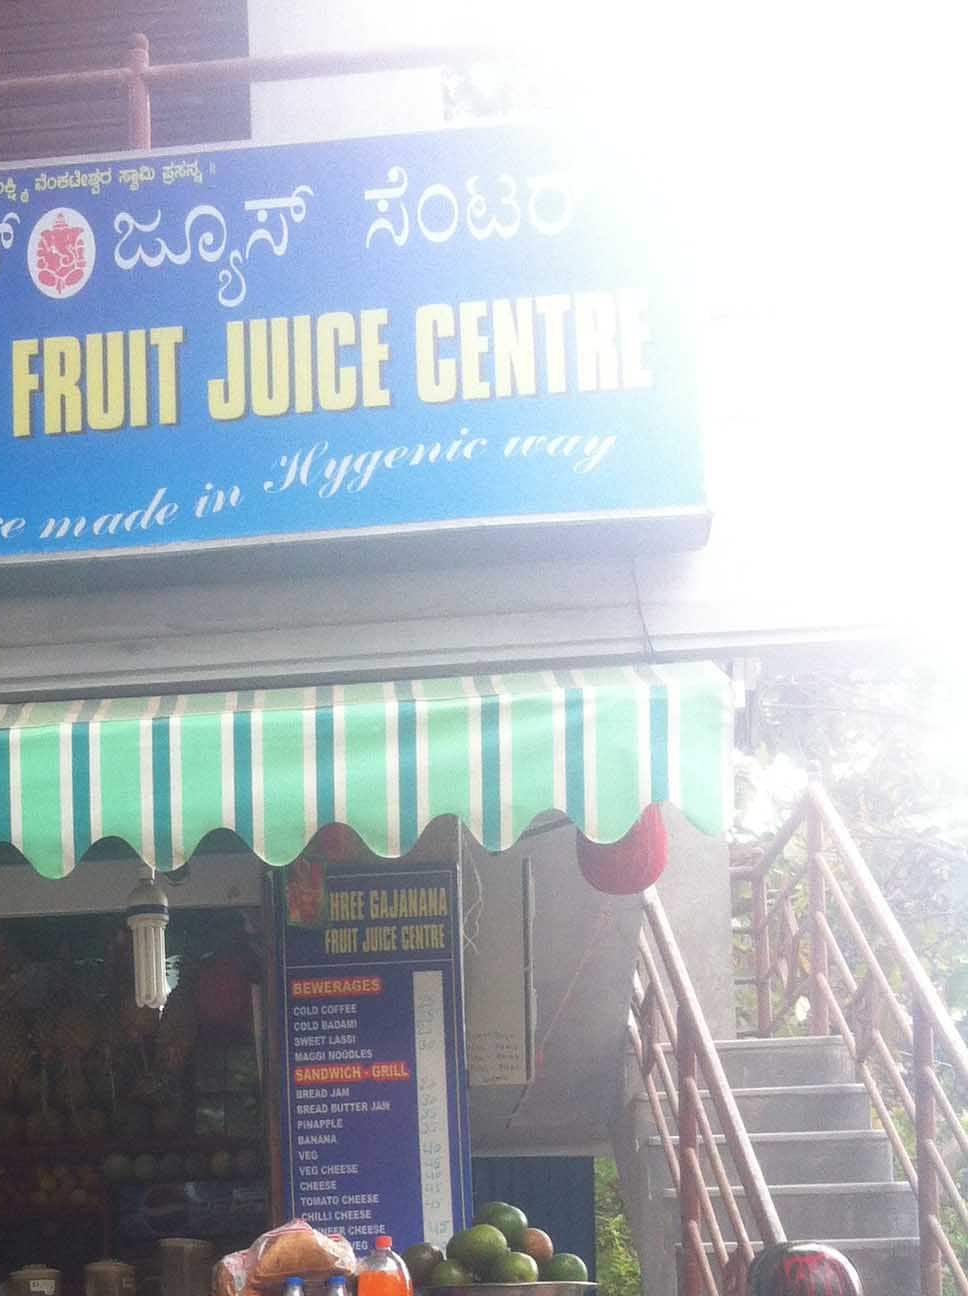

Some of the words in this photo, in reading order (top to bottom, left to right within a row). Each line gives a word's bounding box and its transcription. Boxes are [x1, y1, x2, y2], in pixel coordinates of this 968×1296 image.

[113, 185, 315, 308] ಜ್ಯೂಸ್
[11, 326, 185, 439] FRUIT
[207, 308, 391, 422] JUICE
[415, 288, 654, 404] CENTRE
[38, 487, 180, 541] made
[195, 482, 243, 519] in
[263, 427, 488, 499] Hygenic
[503, 433, 617, 474] way
[370, 887, 448, 920] GAJANANA
[325, 927, 358, 954] FRUIT
[363, 925, 398, 952] JUICE
[401, 923, 446, 950] CENTRE
[294, 978, 381, 994] BEWERAGES
[294, 1007, 319, 1016] COLD
[321, 1004, 357, 1014] COFFEE
[294, 1021, 319, 1031] COLD
[294, 1036, 326, 1046] SWEET
[329, 1034, 356, 1045] LASSI
[328, 1049, 373, 1060] NOODLES
[295, 1065, 361, 1081] SANDWICH
[372, 1063, 409, 1078] GRILL
[296, 1089, 328, 1099] BREAD
[330, 1088, 350, 1097] JAM
[296, 1104, 328, 1114] BREAD
[331, 1102, 369, 1113] BUTTER
[297, 1118, 343, 1129] PINAPPLE
[298, 1134, 337, 1145] BANANA
[298, 1150, 319, 1160] VEG
[299, 1166, 319, 1176] VEG
[320, 1164, 359, 1174] CHEESE
[300, 1180, 337, 1191] CHEESE
[300, 1196, 340, 1206] TOMATO
[341, 1194, 379, 1205] CHEESE
[334, 1210, 372, 1220] CHEESE
[348, 1225, 386, 1235] CHEESE
